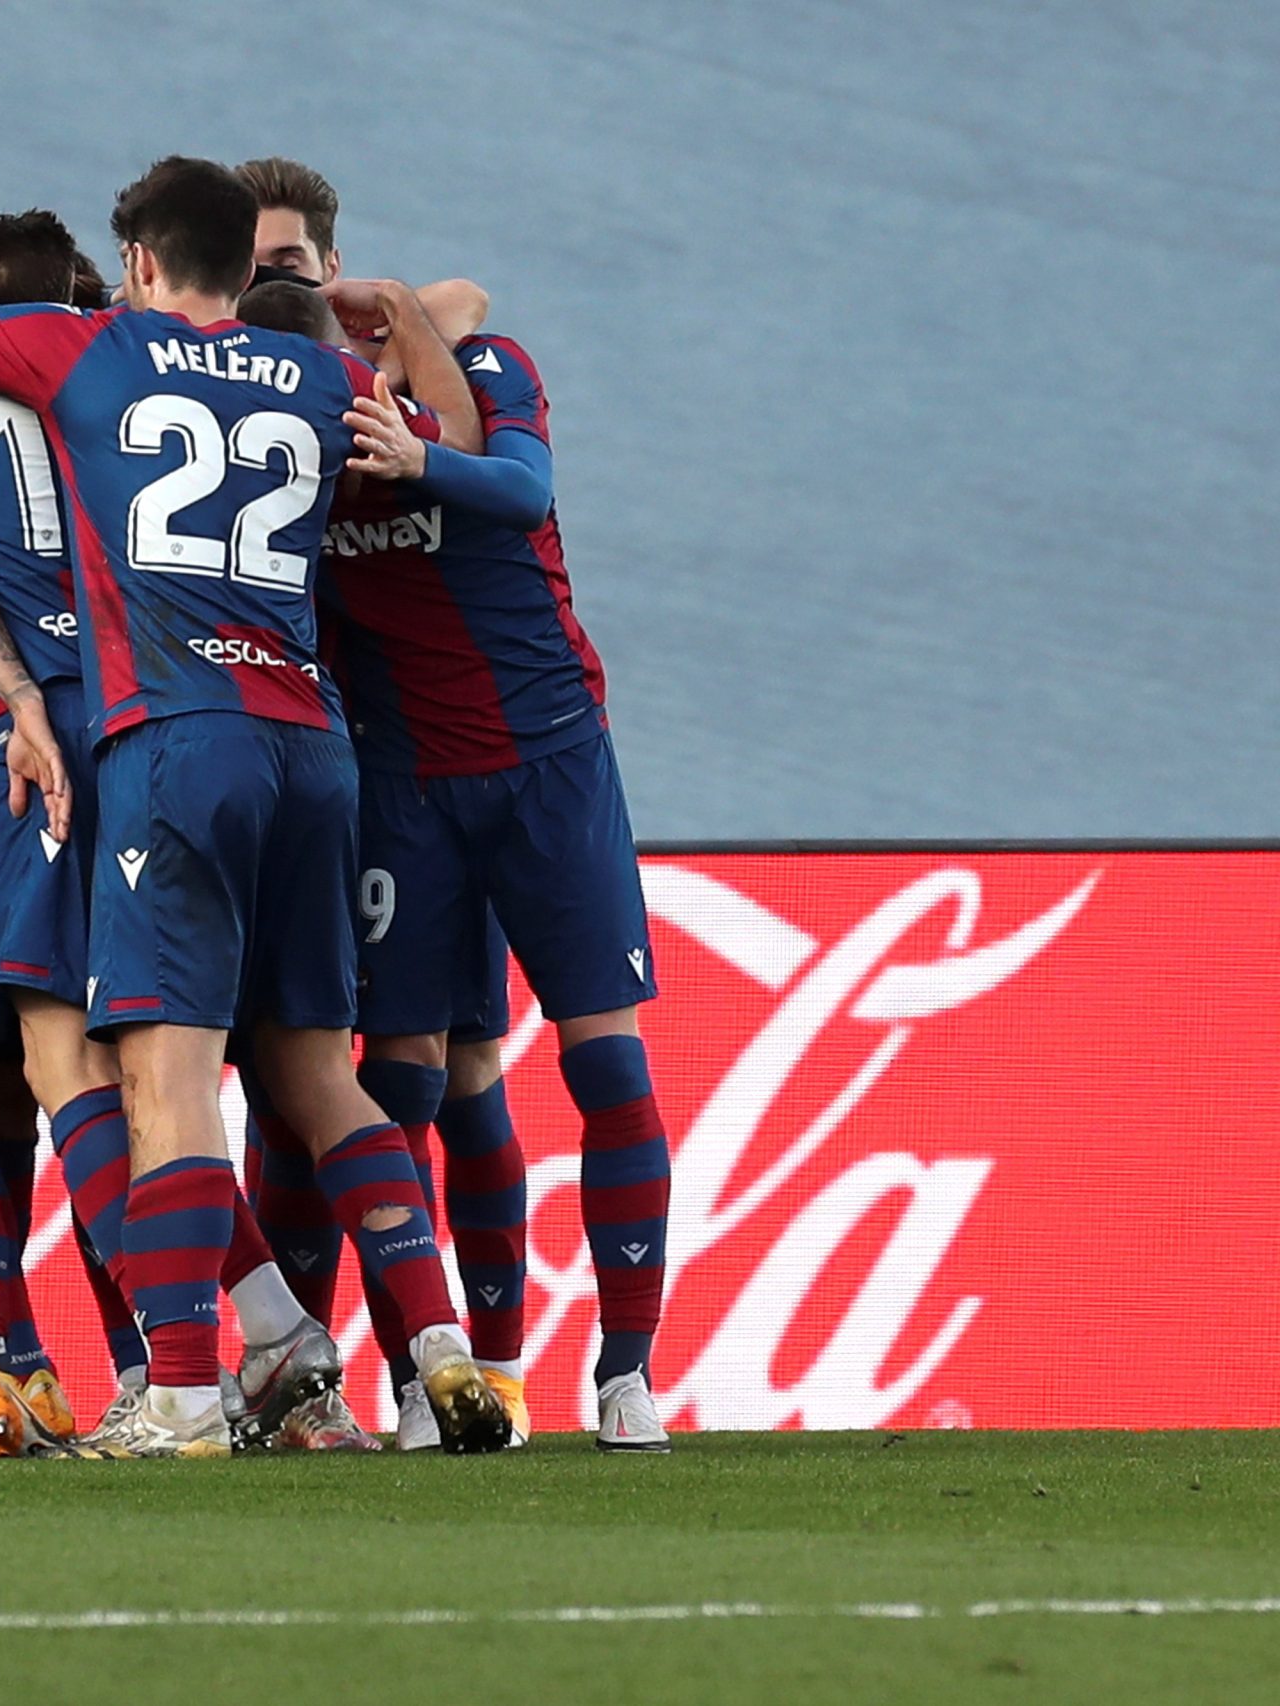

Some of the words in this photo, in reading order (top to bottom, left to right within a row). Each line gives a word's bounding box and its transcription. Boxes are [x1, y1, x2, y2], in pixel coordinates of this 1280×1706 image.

[147, 336, 302, 395] MELERO
[120, 393, 322, 594] 22
[359, 868, 396, 944] 9
